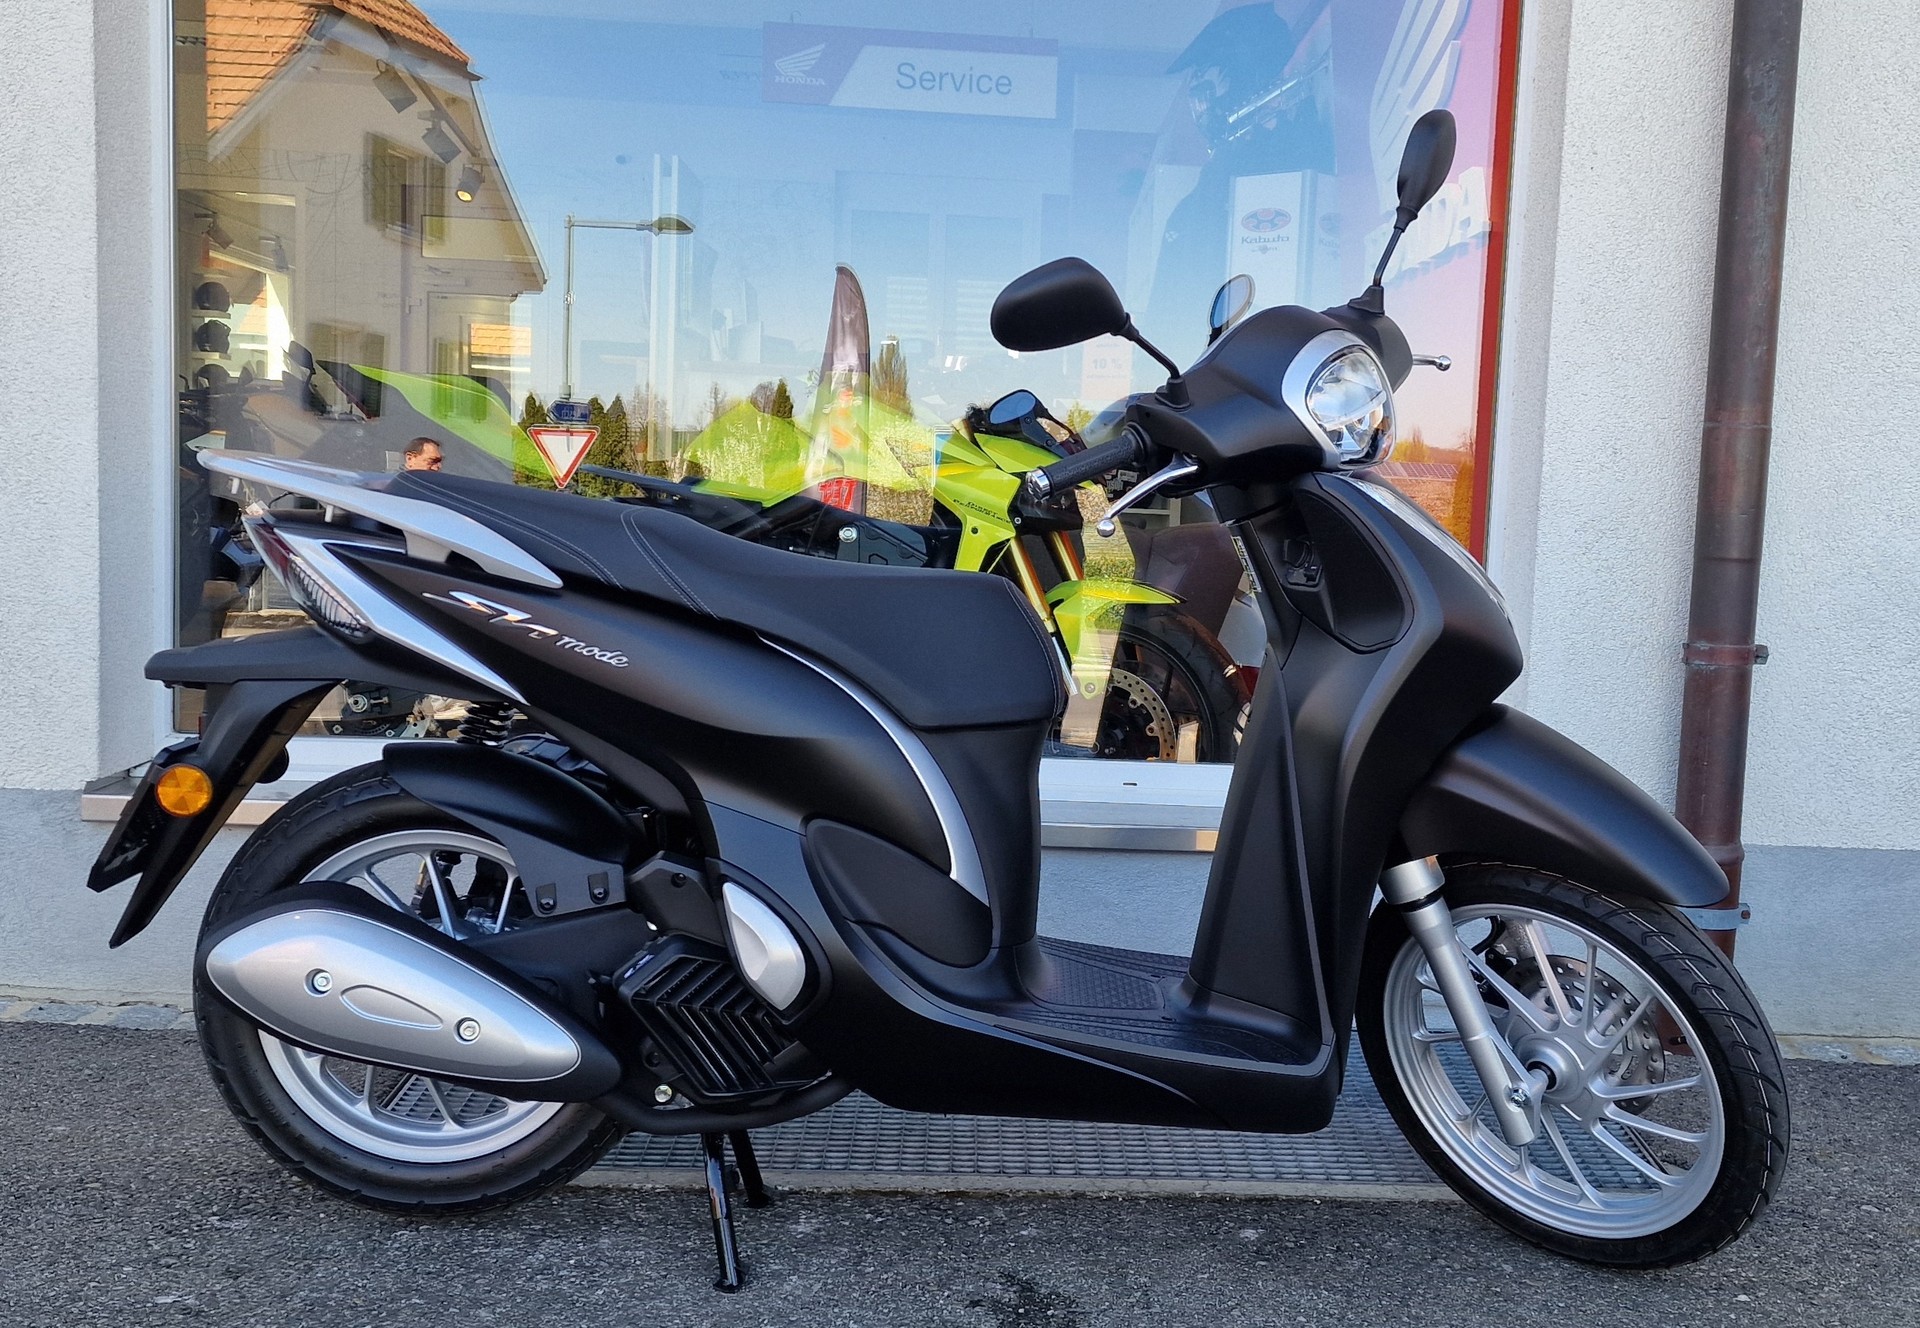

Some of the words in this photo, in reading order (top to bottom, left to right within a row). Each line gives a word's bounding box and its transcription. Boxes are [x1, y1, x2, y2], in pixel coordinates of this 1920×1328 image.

[774, 75, 826, 86] HONDA
[895, 61, 1013, 96] Service
[1241, 234, 1290, 245] Kabuto
[555, 634, 629, 668] mode
